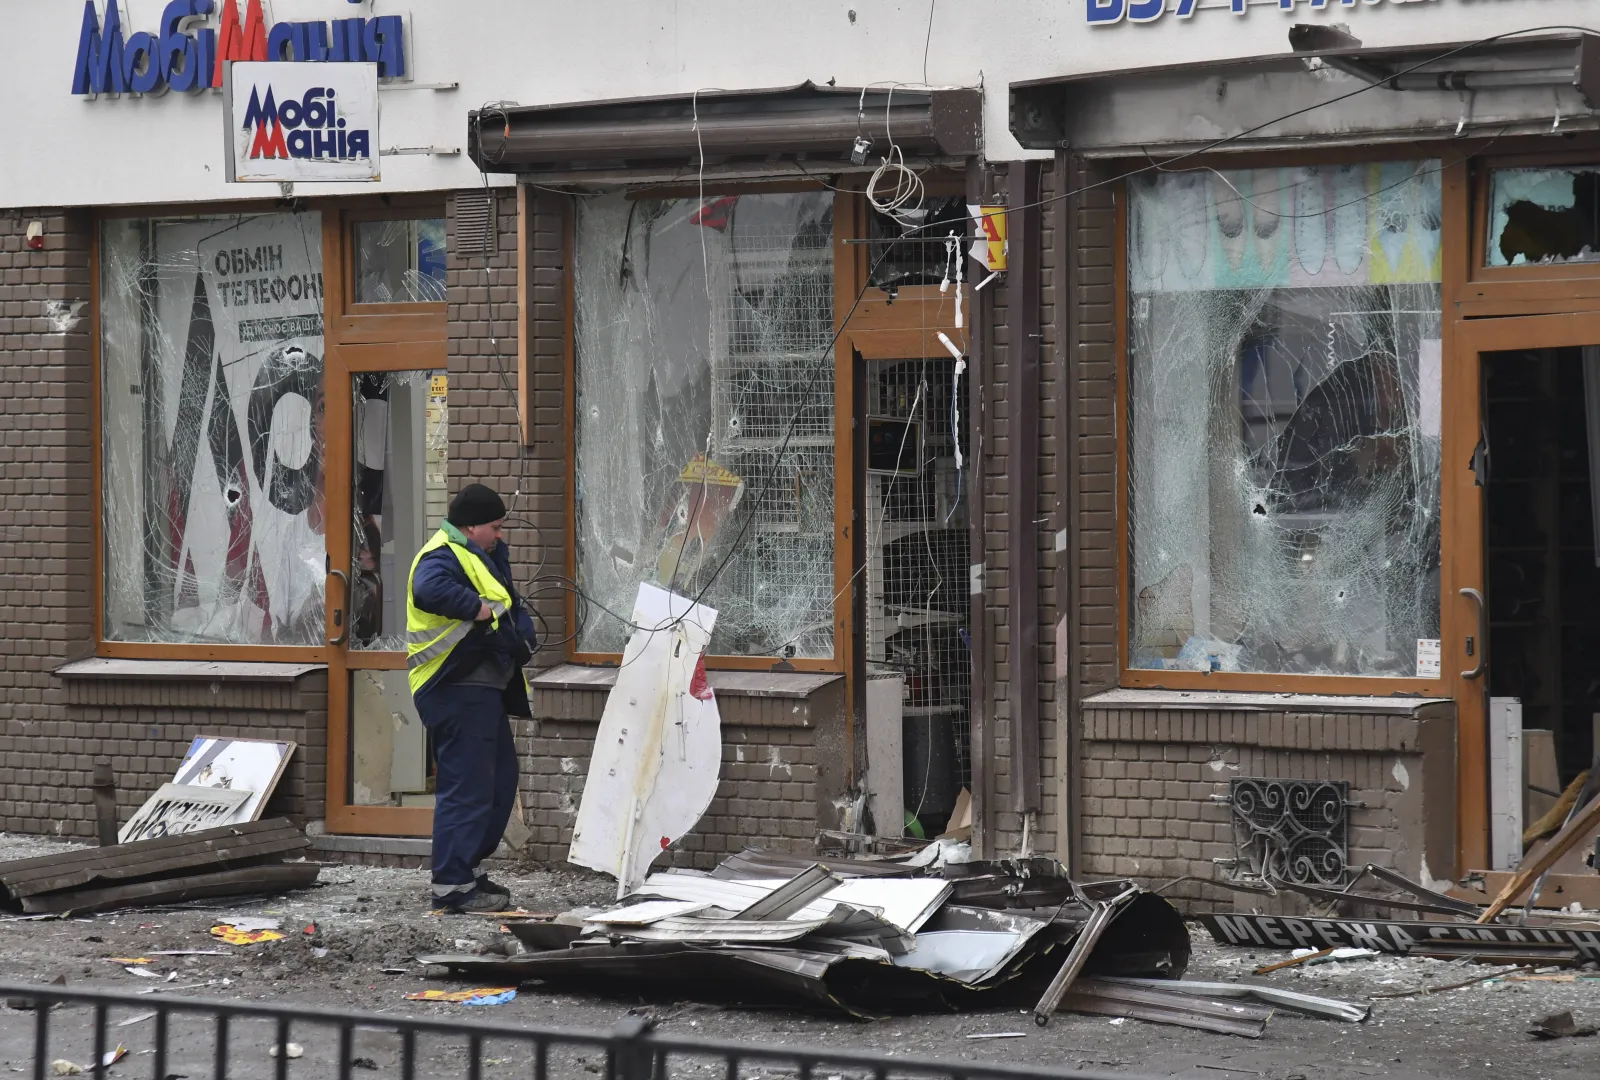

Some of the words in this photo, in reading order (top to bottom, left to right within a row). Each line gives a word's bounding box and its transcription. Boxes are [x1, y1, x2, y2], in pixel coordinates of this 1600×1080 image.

[243, 83, 336, 129] Мобі
[249, 114, 370, 160] Манія
[214, 245, 283, 276] ОБМІН
[1213, 915, 1416, 951] МЕРЕЖА
